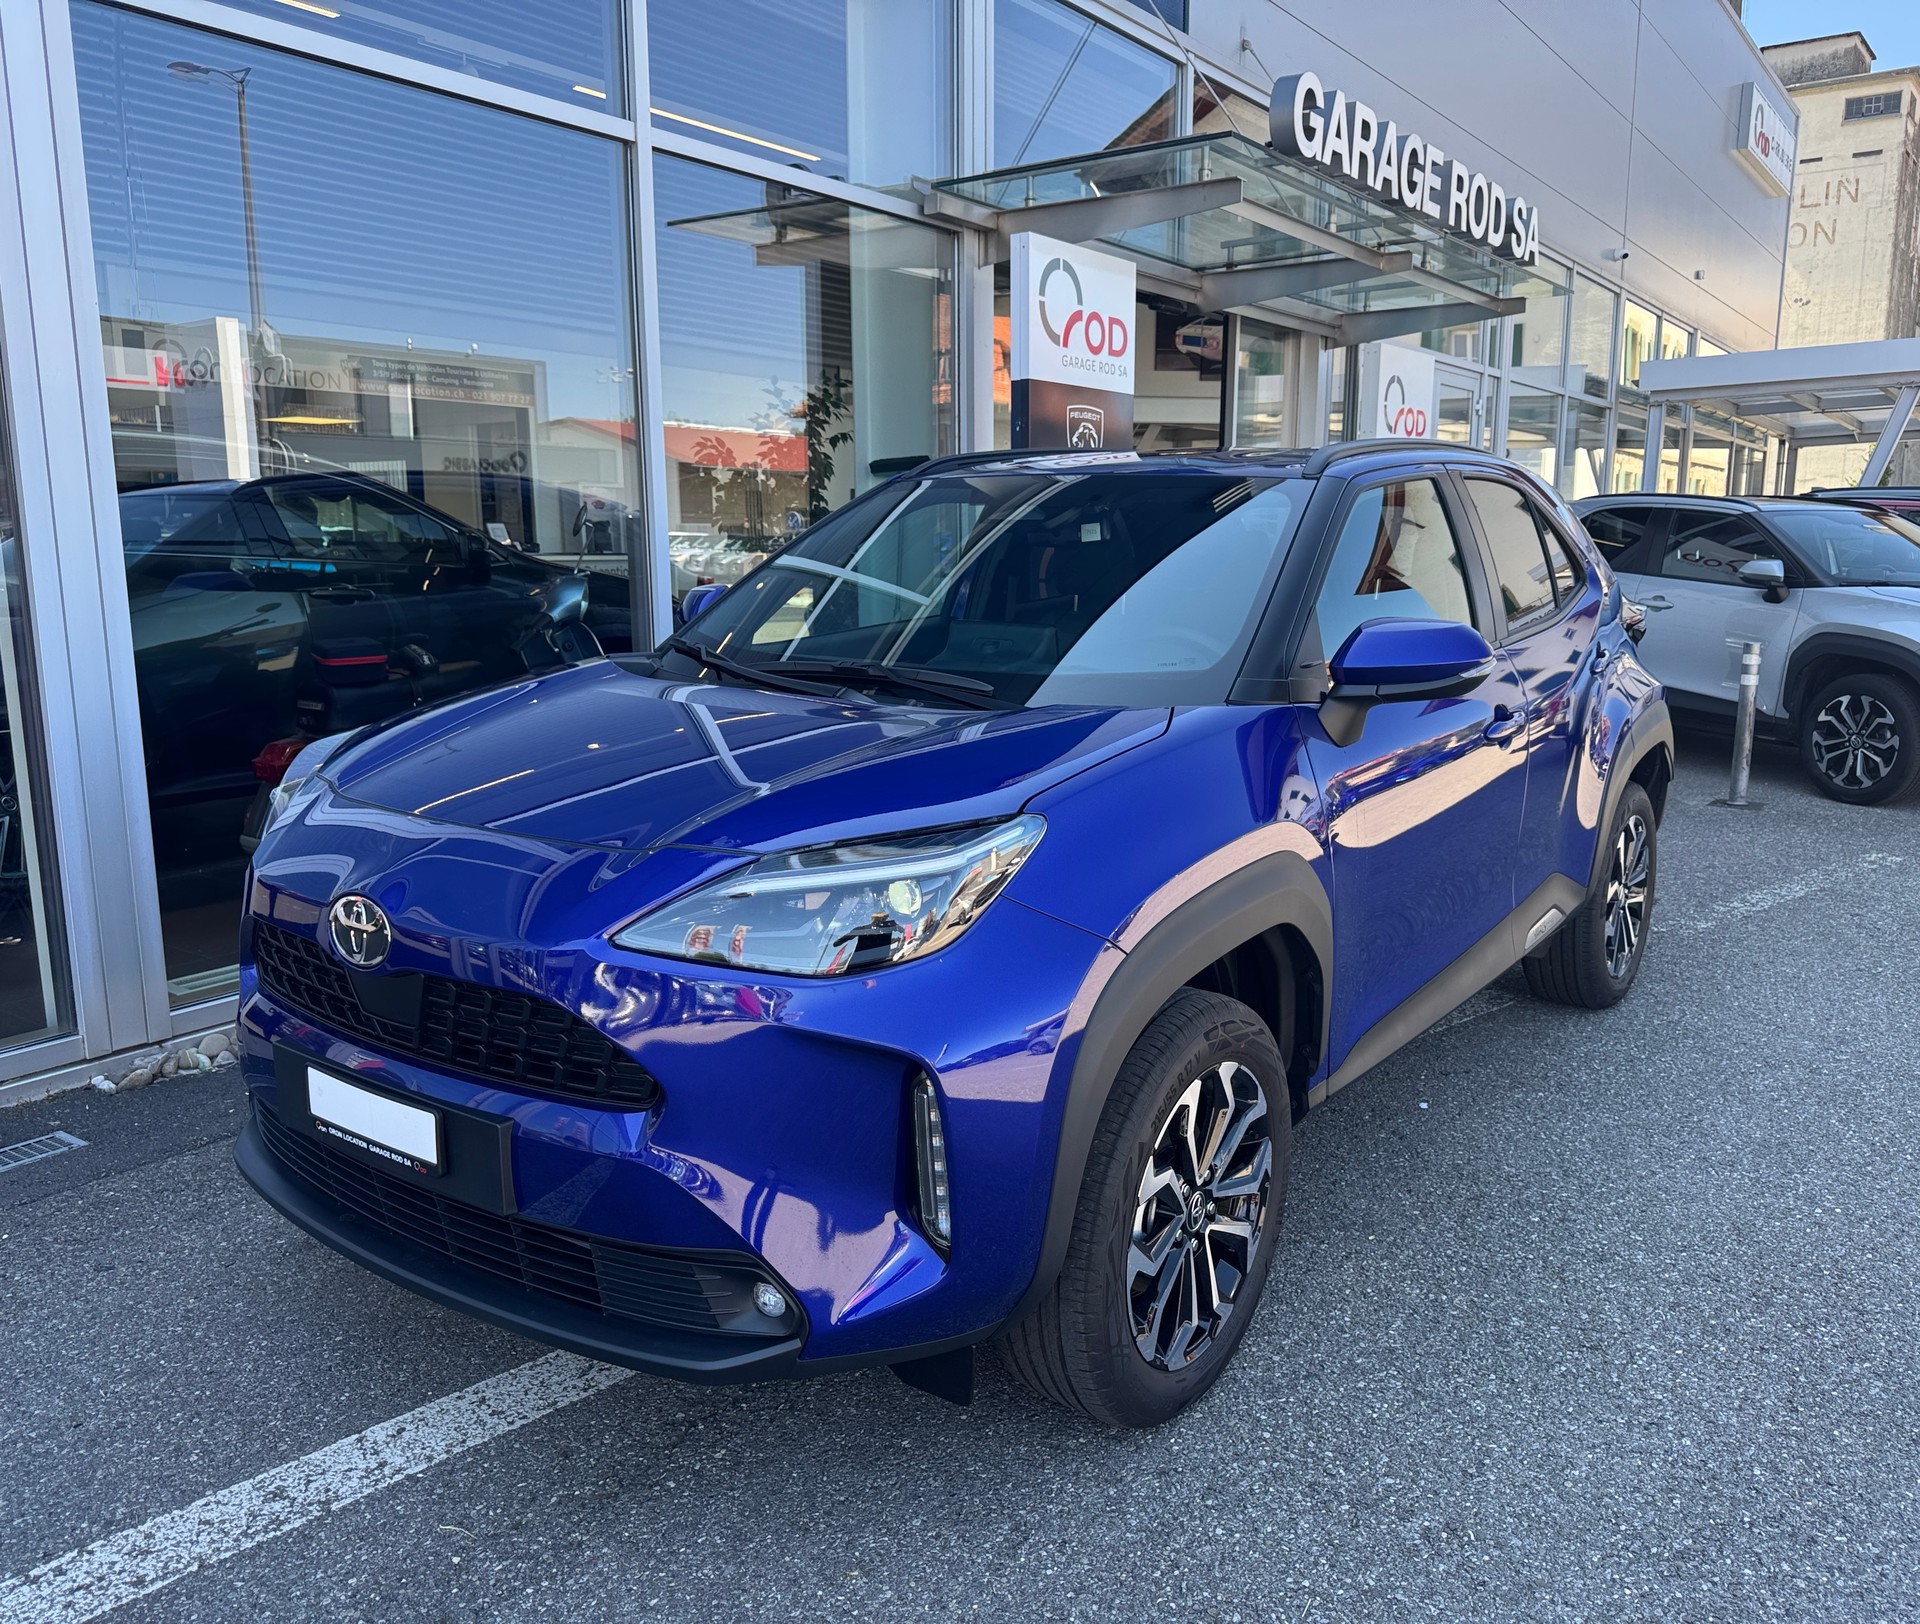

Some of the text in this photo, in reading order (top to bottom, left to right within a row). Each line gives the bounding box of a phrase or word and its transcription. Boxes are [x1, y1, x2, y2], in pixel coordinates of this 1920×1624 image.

[1293, 71, 1539, 266] GARAGE ROD SA
[1061, 355, 1128, 377] GARAGE ROD SA
[1069, 411, 1101, 422] PEUGEOT
[1150, 1084, 1177, 1133] 215/55
[328, 1126, 343, 1139] ORON
[343, 1133, 368, 1149] LOCATION
[369, 1144, 391, 1159] GARAGE
[391, 1153, 404, 1164] ROD
